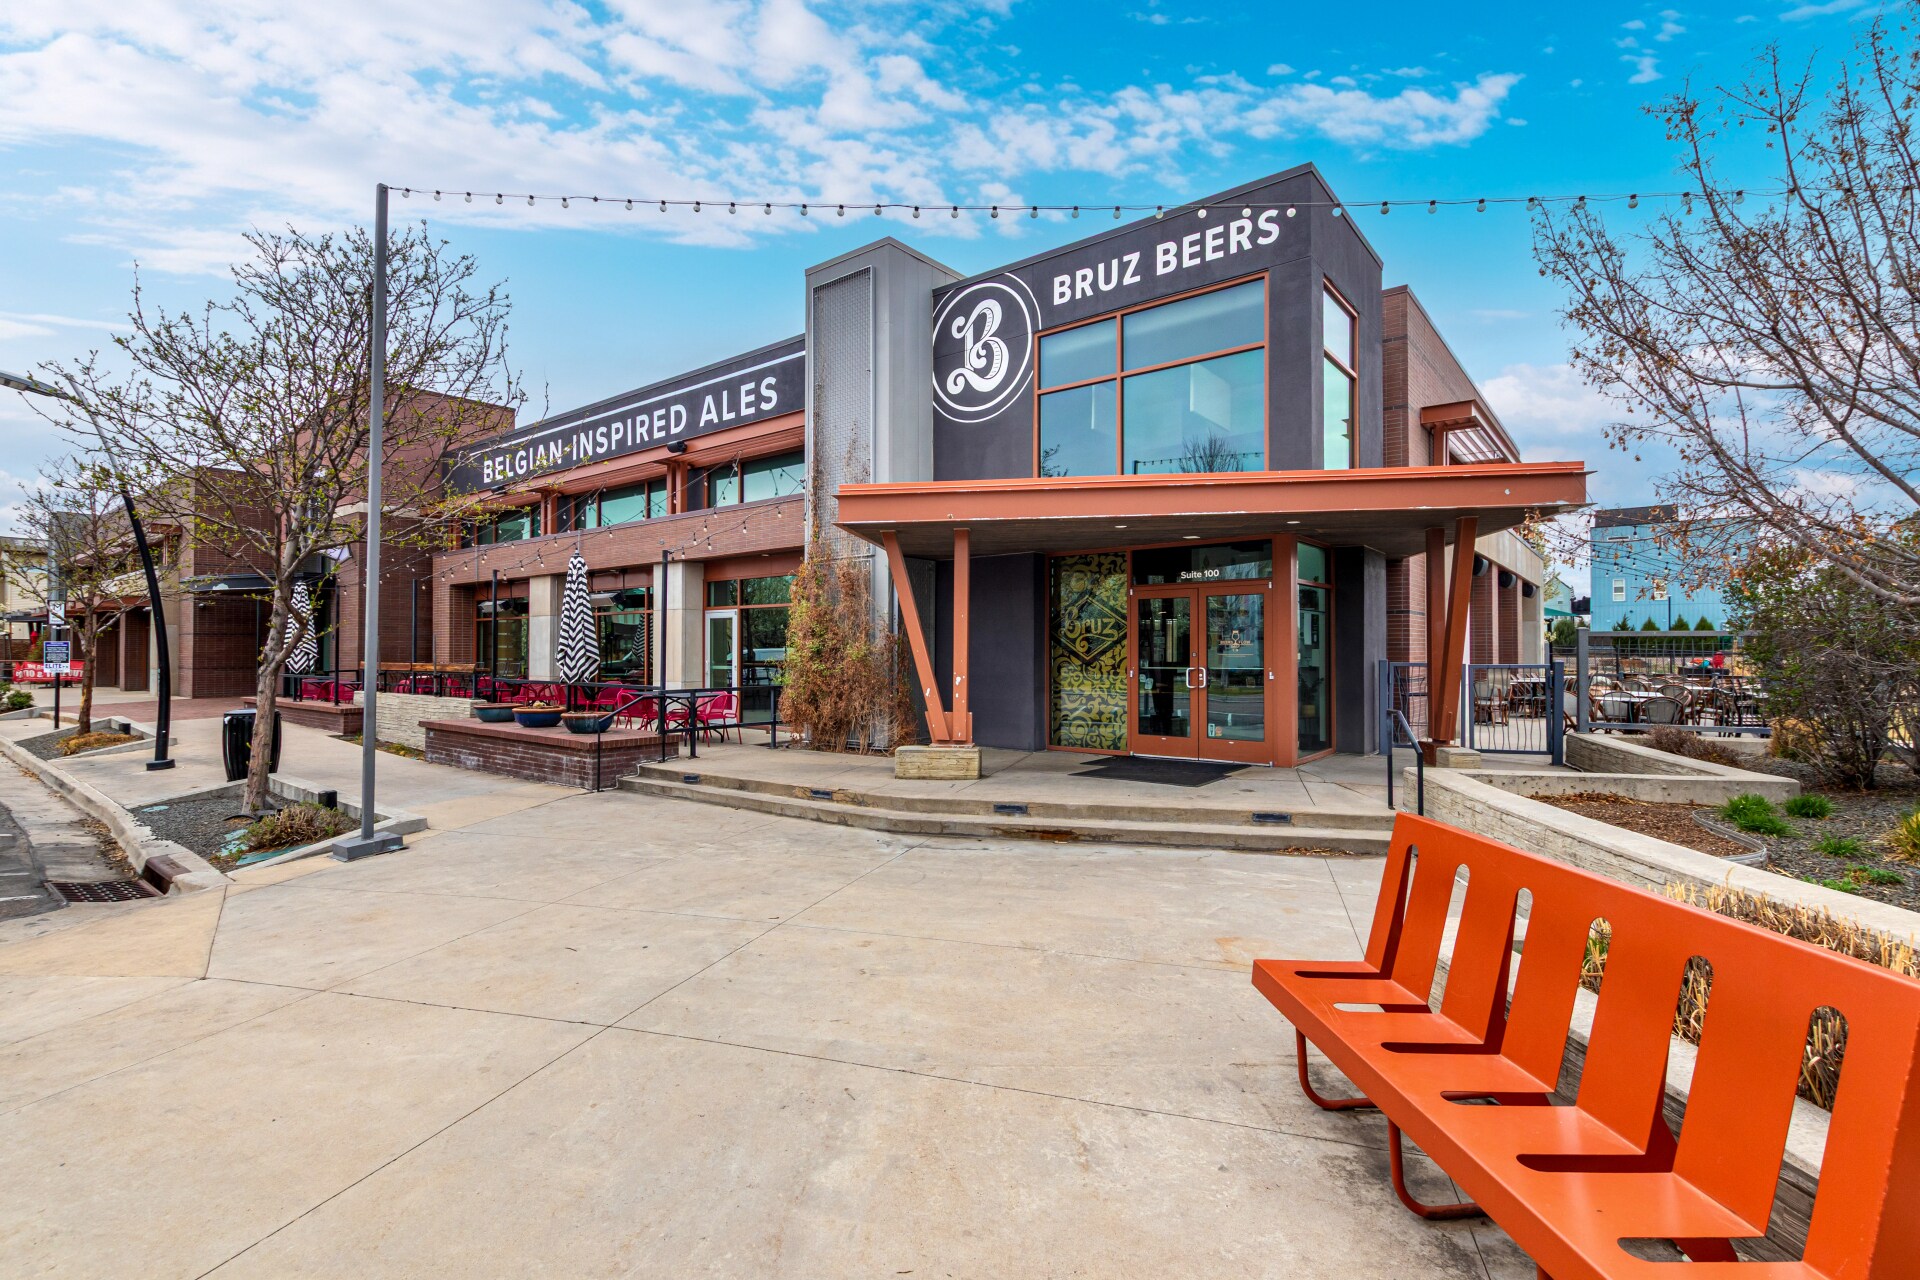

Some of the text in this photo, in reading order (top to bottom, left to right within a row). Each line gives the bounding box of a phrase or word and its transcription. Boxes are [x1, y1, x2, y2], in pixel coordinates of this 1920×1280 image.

[1053, 209, 1280, 306] BRUZ BEERS
[946, 298, 1009, 395] B
[699, 376, 778, 427] ALES
[1180, 569, 1220, 579] Suite 100
